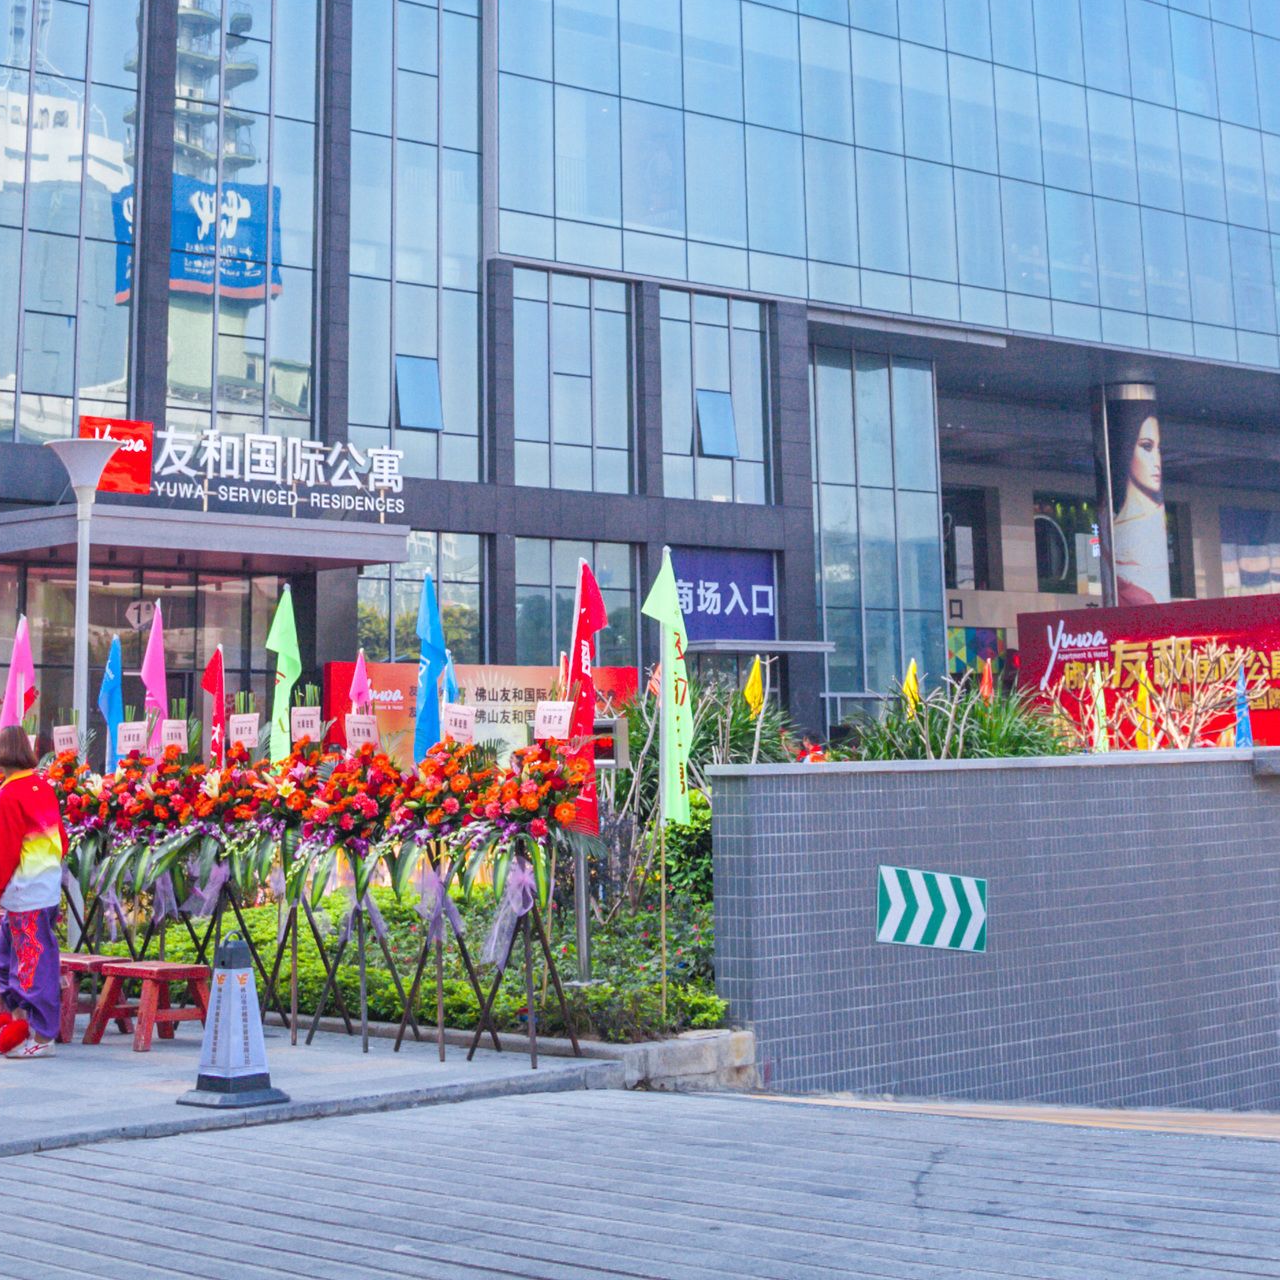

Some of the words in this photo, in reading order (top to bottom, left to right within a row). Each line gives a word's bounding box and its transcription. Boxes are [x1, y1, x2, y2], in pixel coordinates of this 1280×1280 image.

[154, 426, 404, 493] 友和国际公寓
[155, 481, 205, 499] YUWA
[218, 488, 298, 507] SERVICED
[310, 493, 405, 513] RESIDENCES
[676, 580, 774, 616] 商场入口
[1040, 619, 1107, 691] Yuwa
